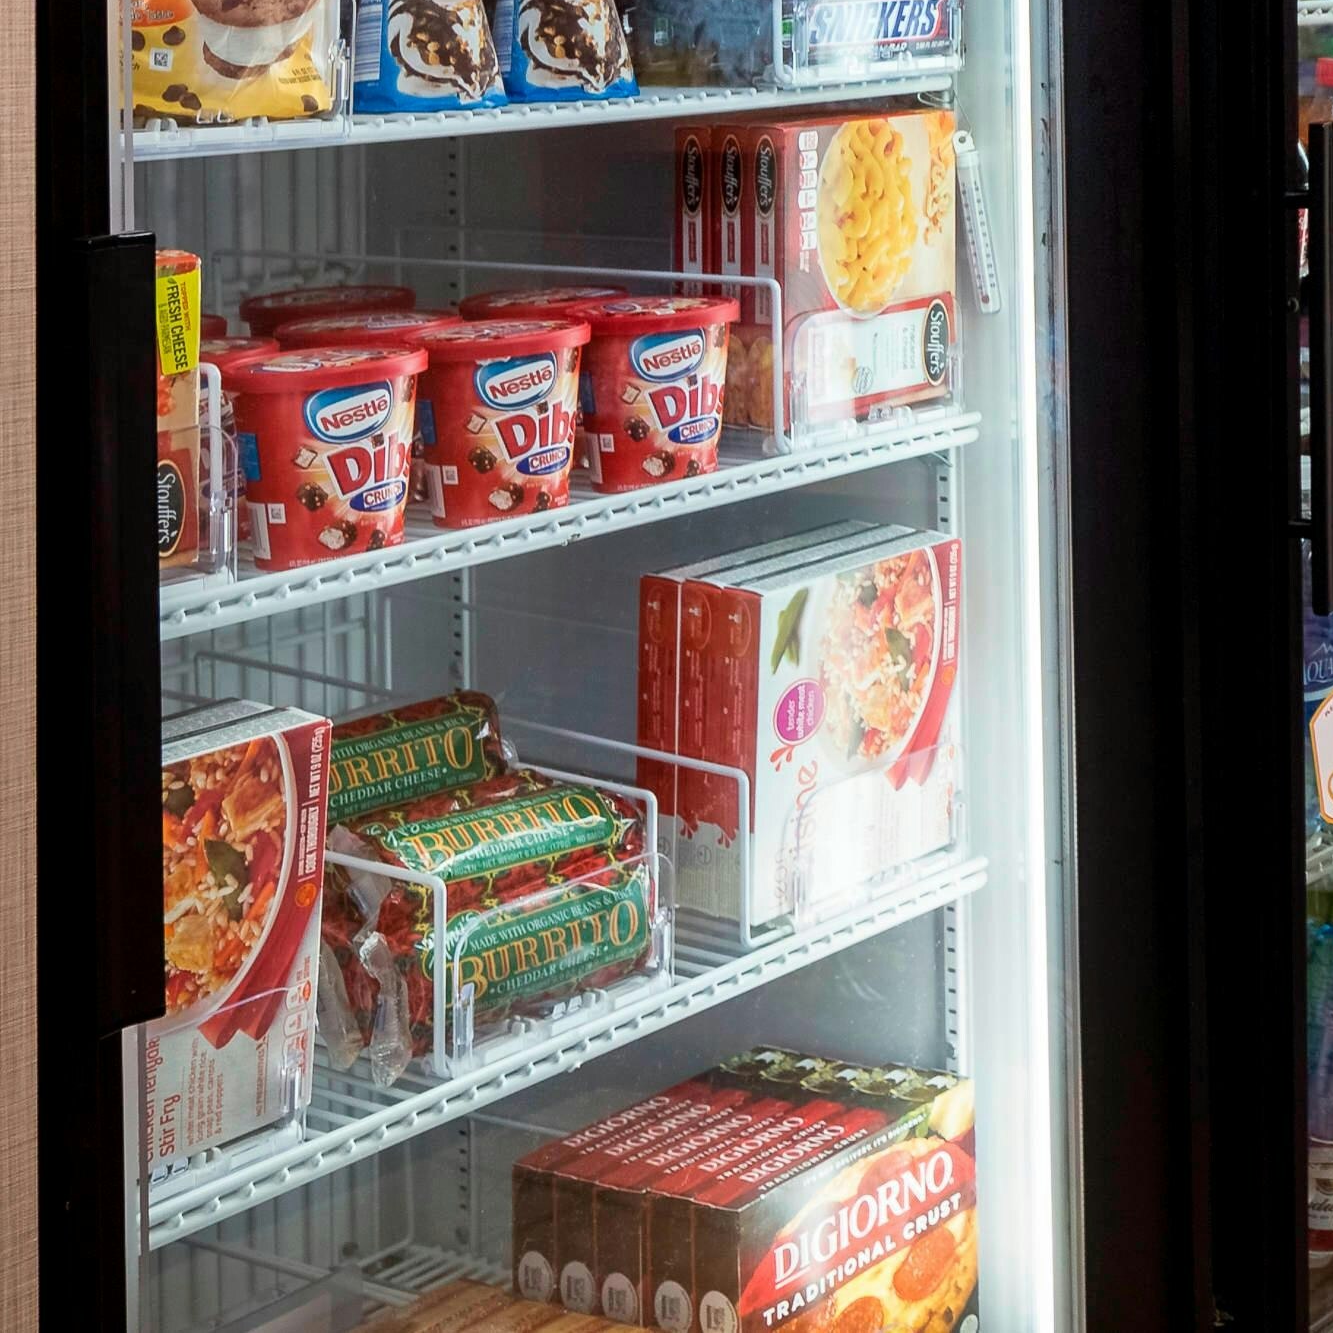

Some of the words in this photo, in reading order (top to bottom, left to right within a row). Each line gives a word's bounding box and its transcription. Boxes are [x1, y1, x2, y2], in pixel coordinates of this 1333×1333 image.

[759, 143, 774, 207] Stouffer's
[166, 284, 182, 323] FRESH
[172, 324, 188, 370] CHEESE
[929, 310, 944, 375] Stouffer's
[488, 366, 554, 400] Nestlé
[320, 394, 390, 430] Nestlé
[527, 448, 569, 473] CRUNCH
[363, 482, 405, 507] CRUNCH
[403, 794, 601, 870] BURRITO
[470, 935, 498, 952] MADE
[500, 926, 526, 943] WITH
[527, 910, 569, 931] ORGANIC
[571, 900, 600, 917] BEANS
[445, 900, 638, 1005] BURRITO
[160, 1095, 181, 1125] Fry
[159, 1128, 175, 1158] Stir
[773, 1150, 953, 1289] DIGIORNO
[763, 1236, 896, 1327] TRADITIONAL
[902, 1193, 962, 1240] CRUST
